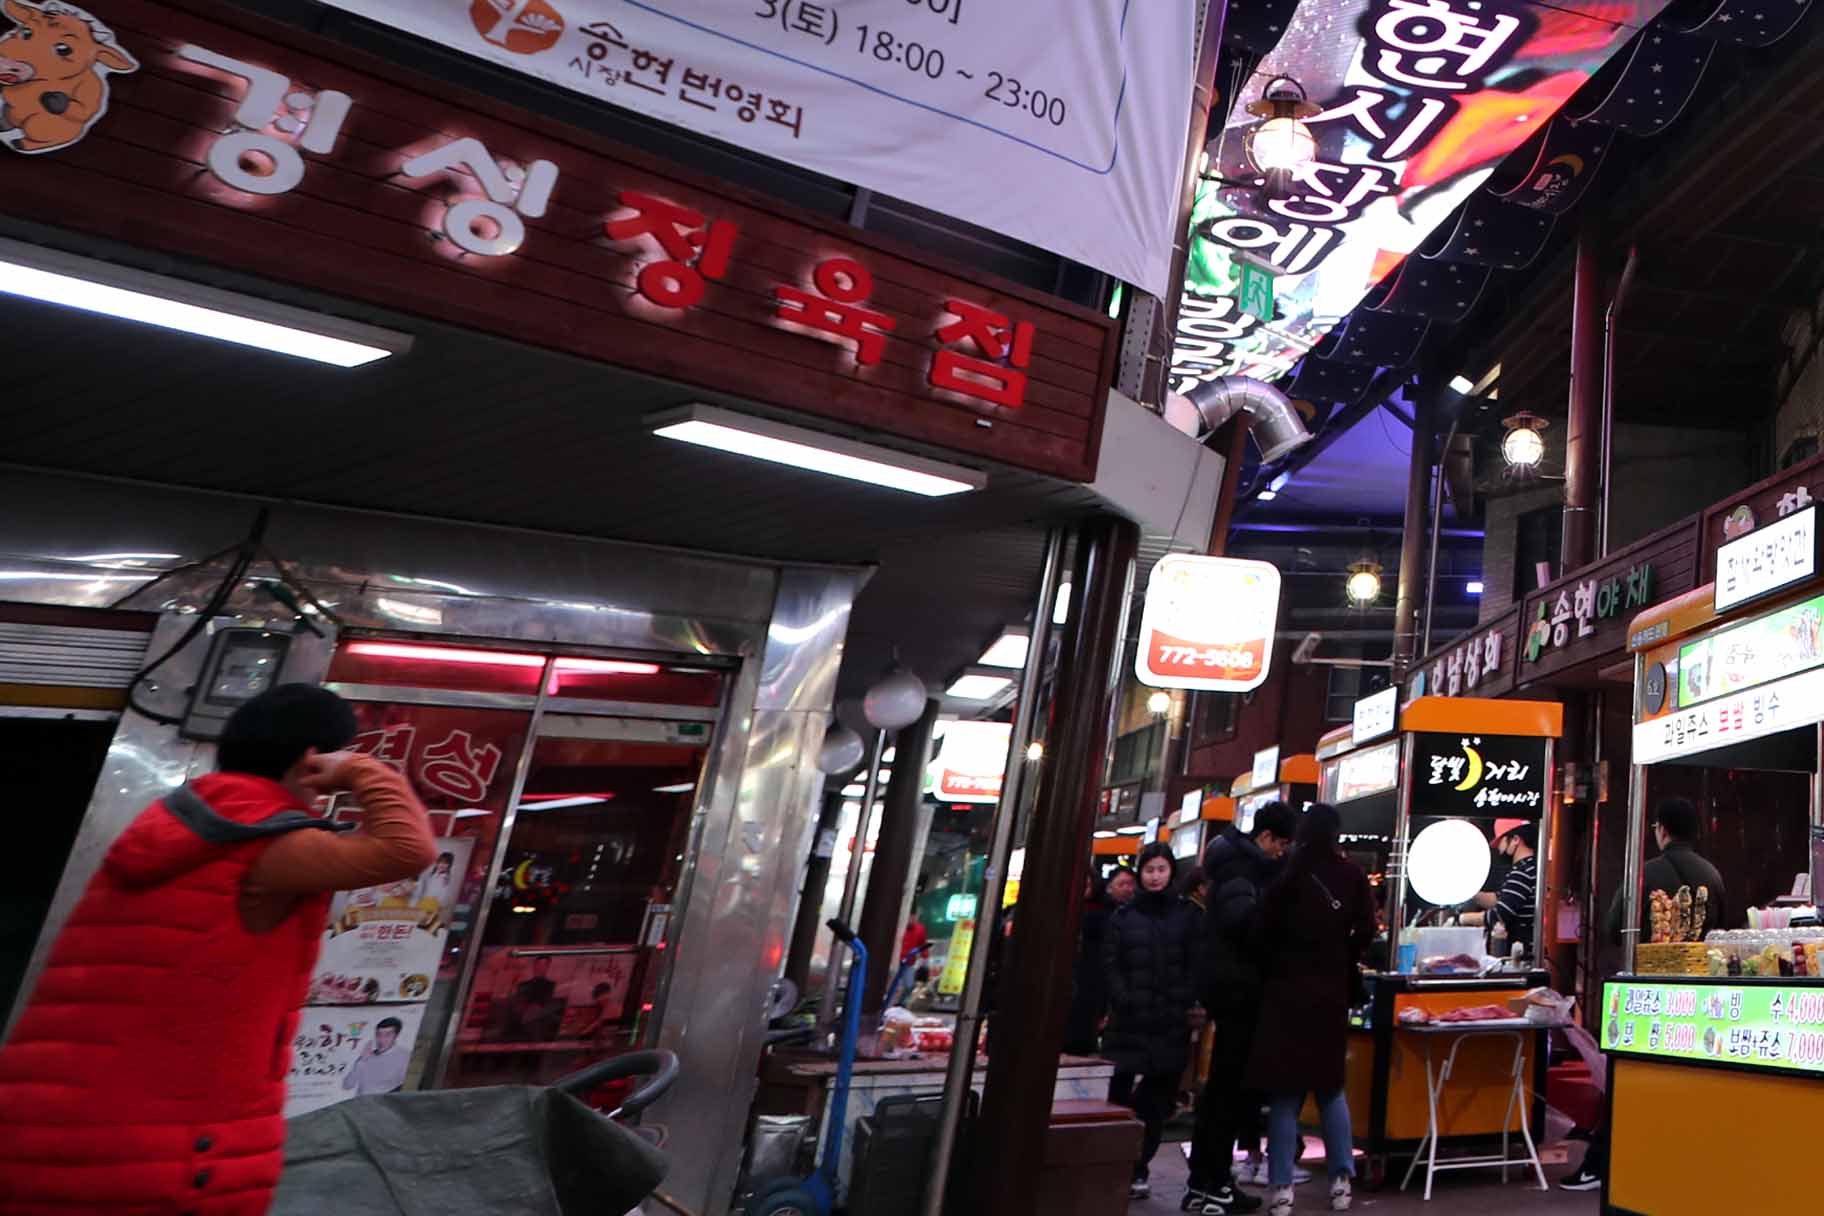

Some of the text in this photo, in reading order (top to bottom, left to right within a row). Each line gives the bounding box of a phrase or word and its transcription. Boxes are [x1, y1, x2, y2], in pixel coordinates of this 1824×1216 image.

[854, 22, 947, 82] 18:00
[983, 69, 1069, 129] 23:00
[1551, 563, 1650, 648] 송현야채
[1663, 711, 1709, 748] 과일쥬스
